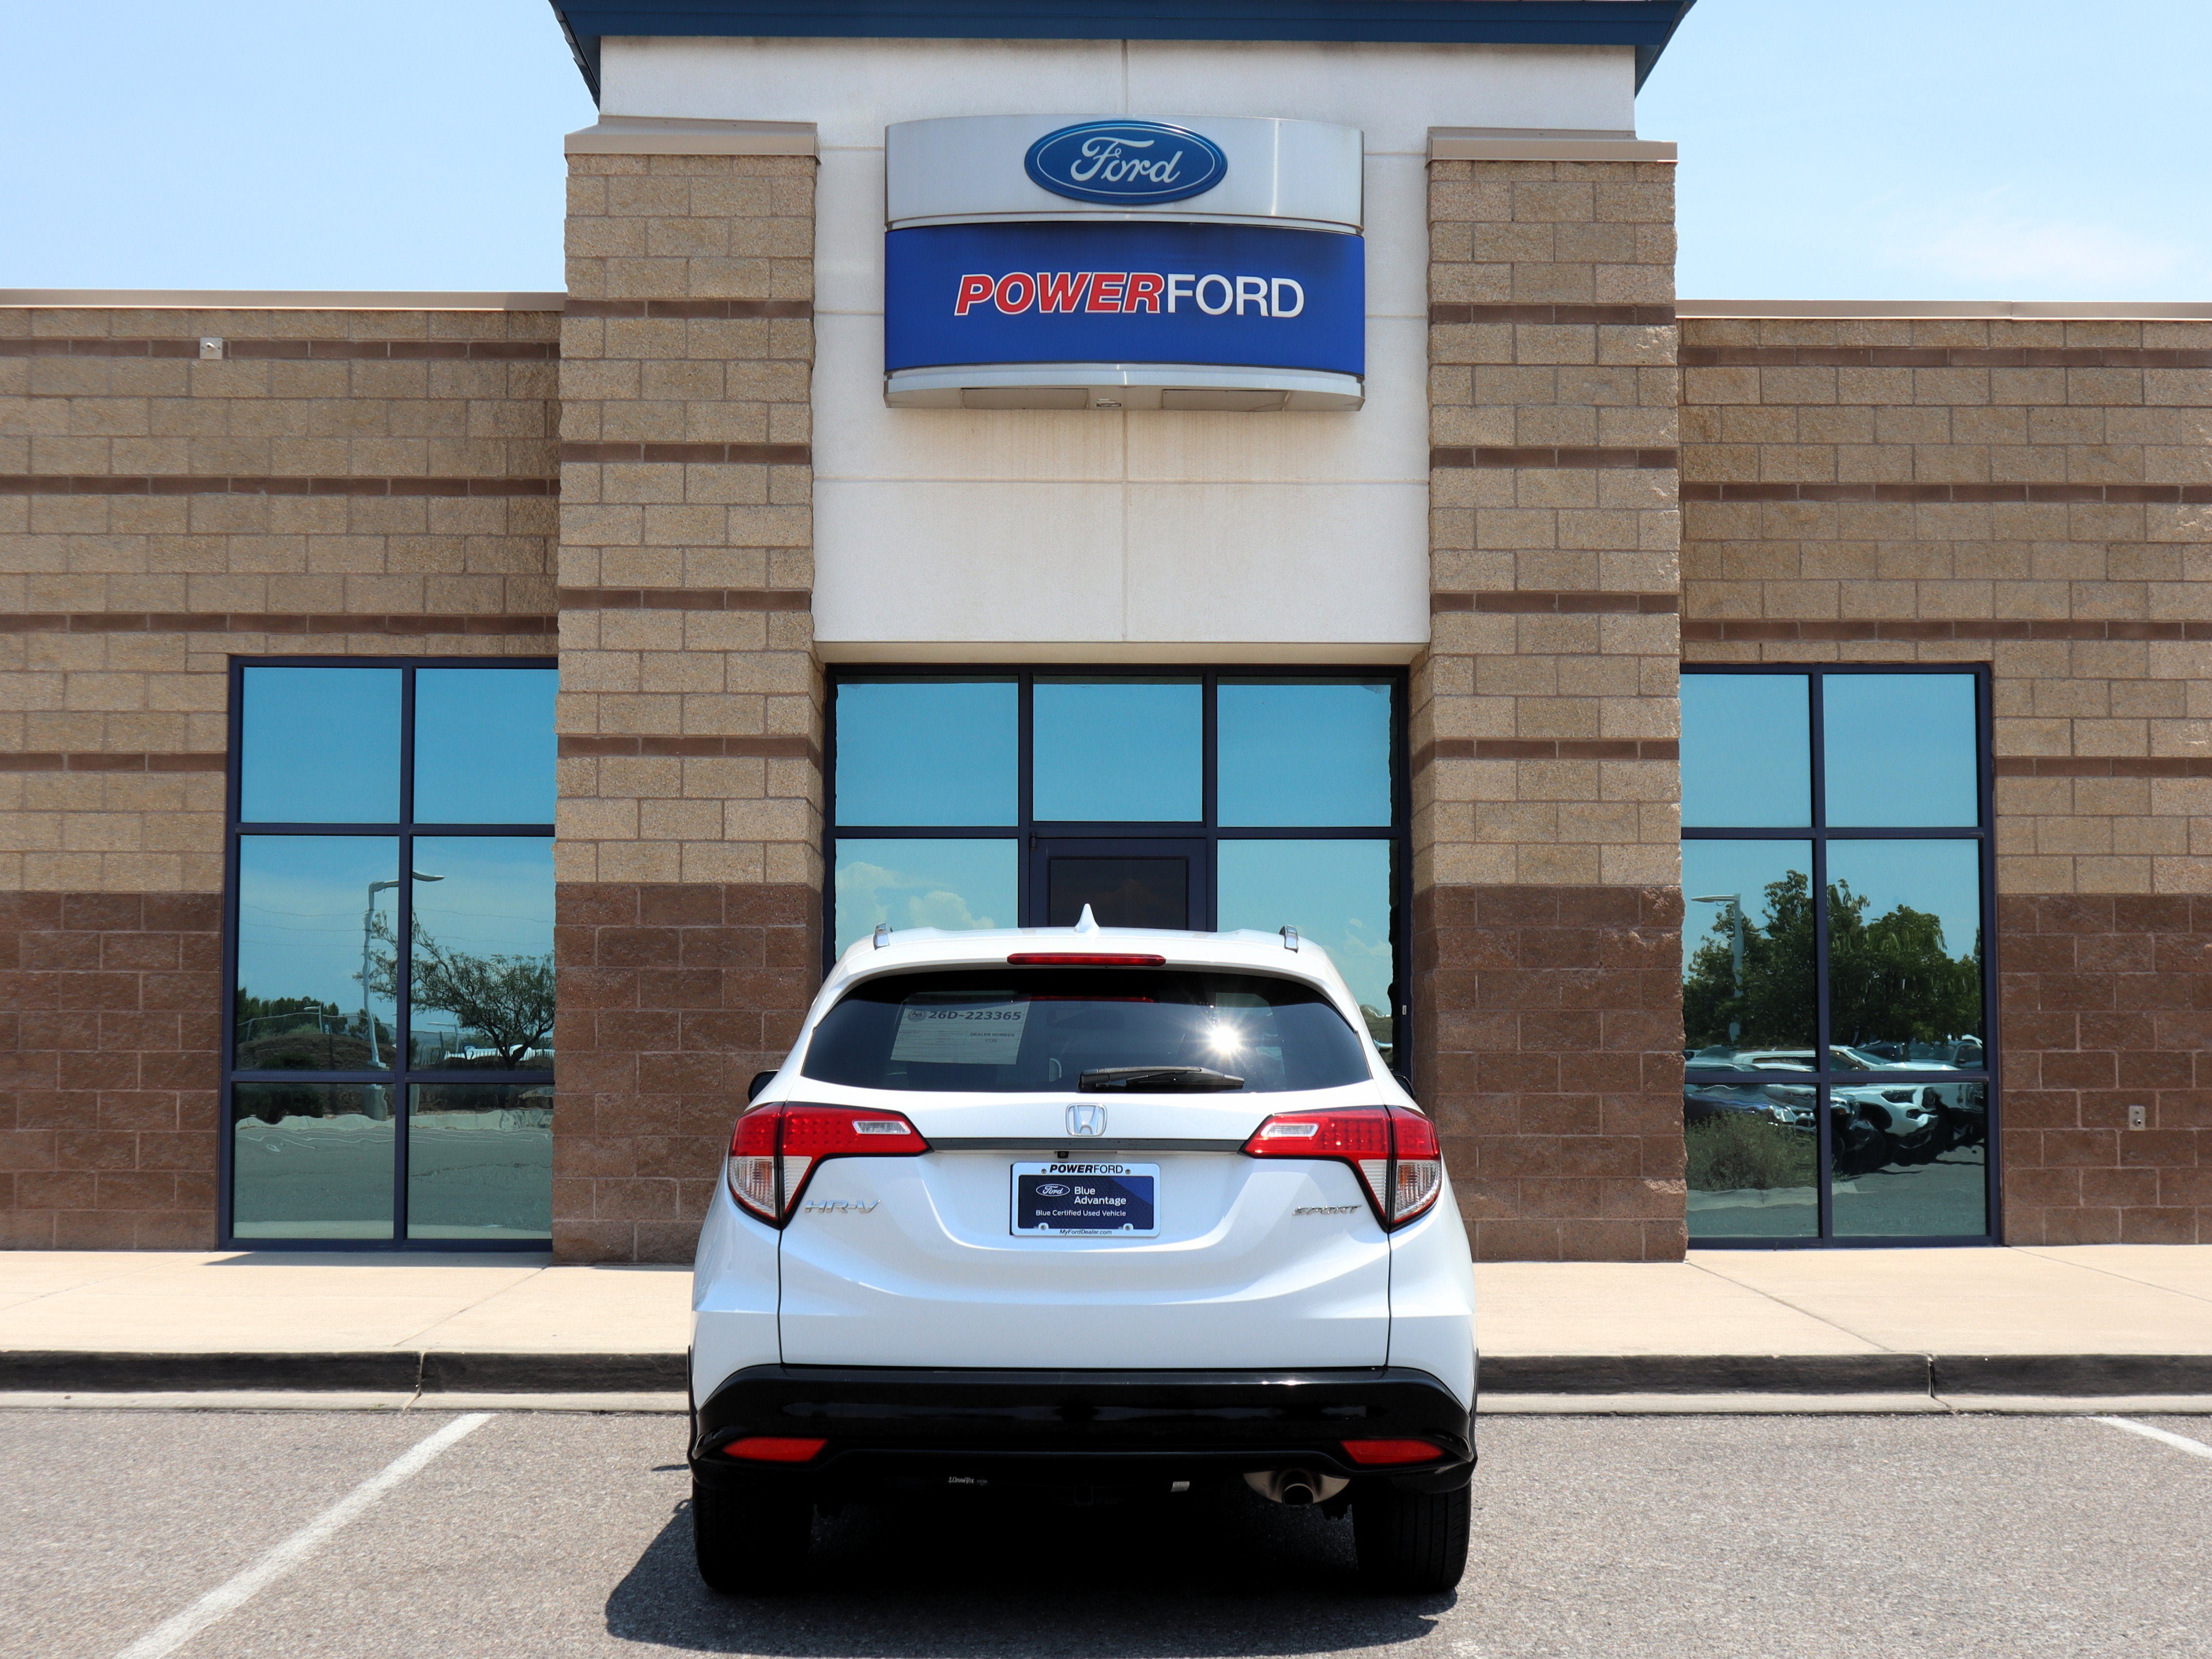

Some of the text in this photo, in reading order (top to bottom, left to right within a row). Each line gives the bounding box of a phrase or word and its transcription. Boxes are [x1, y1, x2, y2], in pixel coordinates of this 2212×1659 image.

[1070, 136, 1183, 184] Ford
[954, 271, 1304, 318] POWERFORD
[928, 1011, 1022, 1020] 26D-223365
[1049, 1164, 1123, 1173] POWERFORD
[1042, 1185, 1064, 1195] Ford
[1075, 1186, 1096, 1195] Blue
[1074, 1196, 1127, 1206] Advantage
[804, 1199, 880, 1214] HR-V
[1292, 1204, 1362, 1216] SPORT
